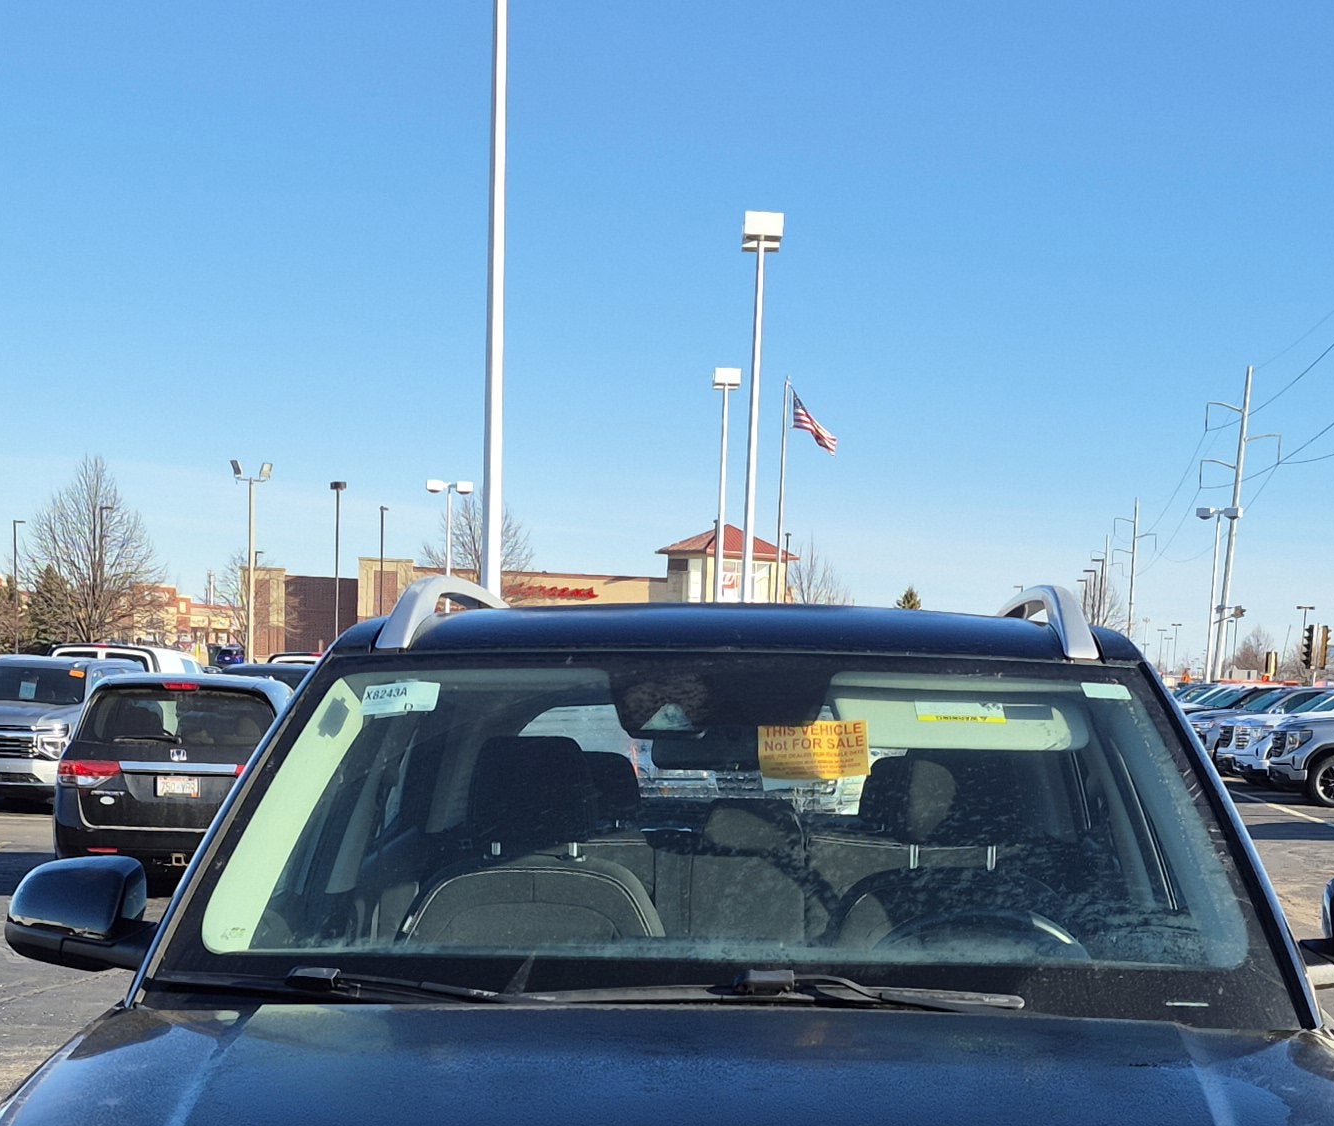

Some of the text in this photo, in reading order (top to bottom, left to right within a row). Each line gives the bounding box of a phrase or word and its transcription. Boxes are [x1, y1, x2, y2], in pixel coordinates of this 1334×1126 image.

[365, 687, 407, 700] X8243A
[766, 722, 862, 737] THIS VEHICLE
[764, 735, 864, 752] Not FOR SALE
